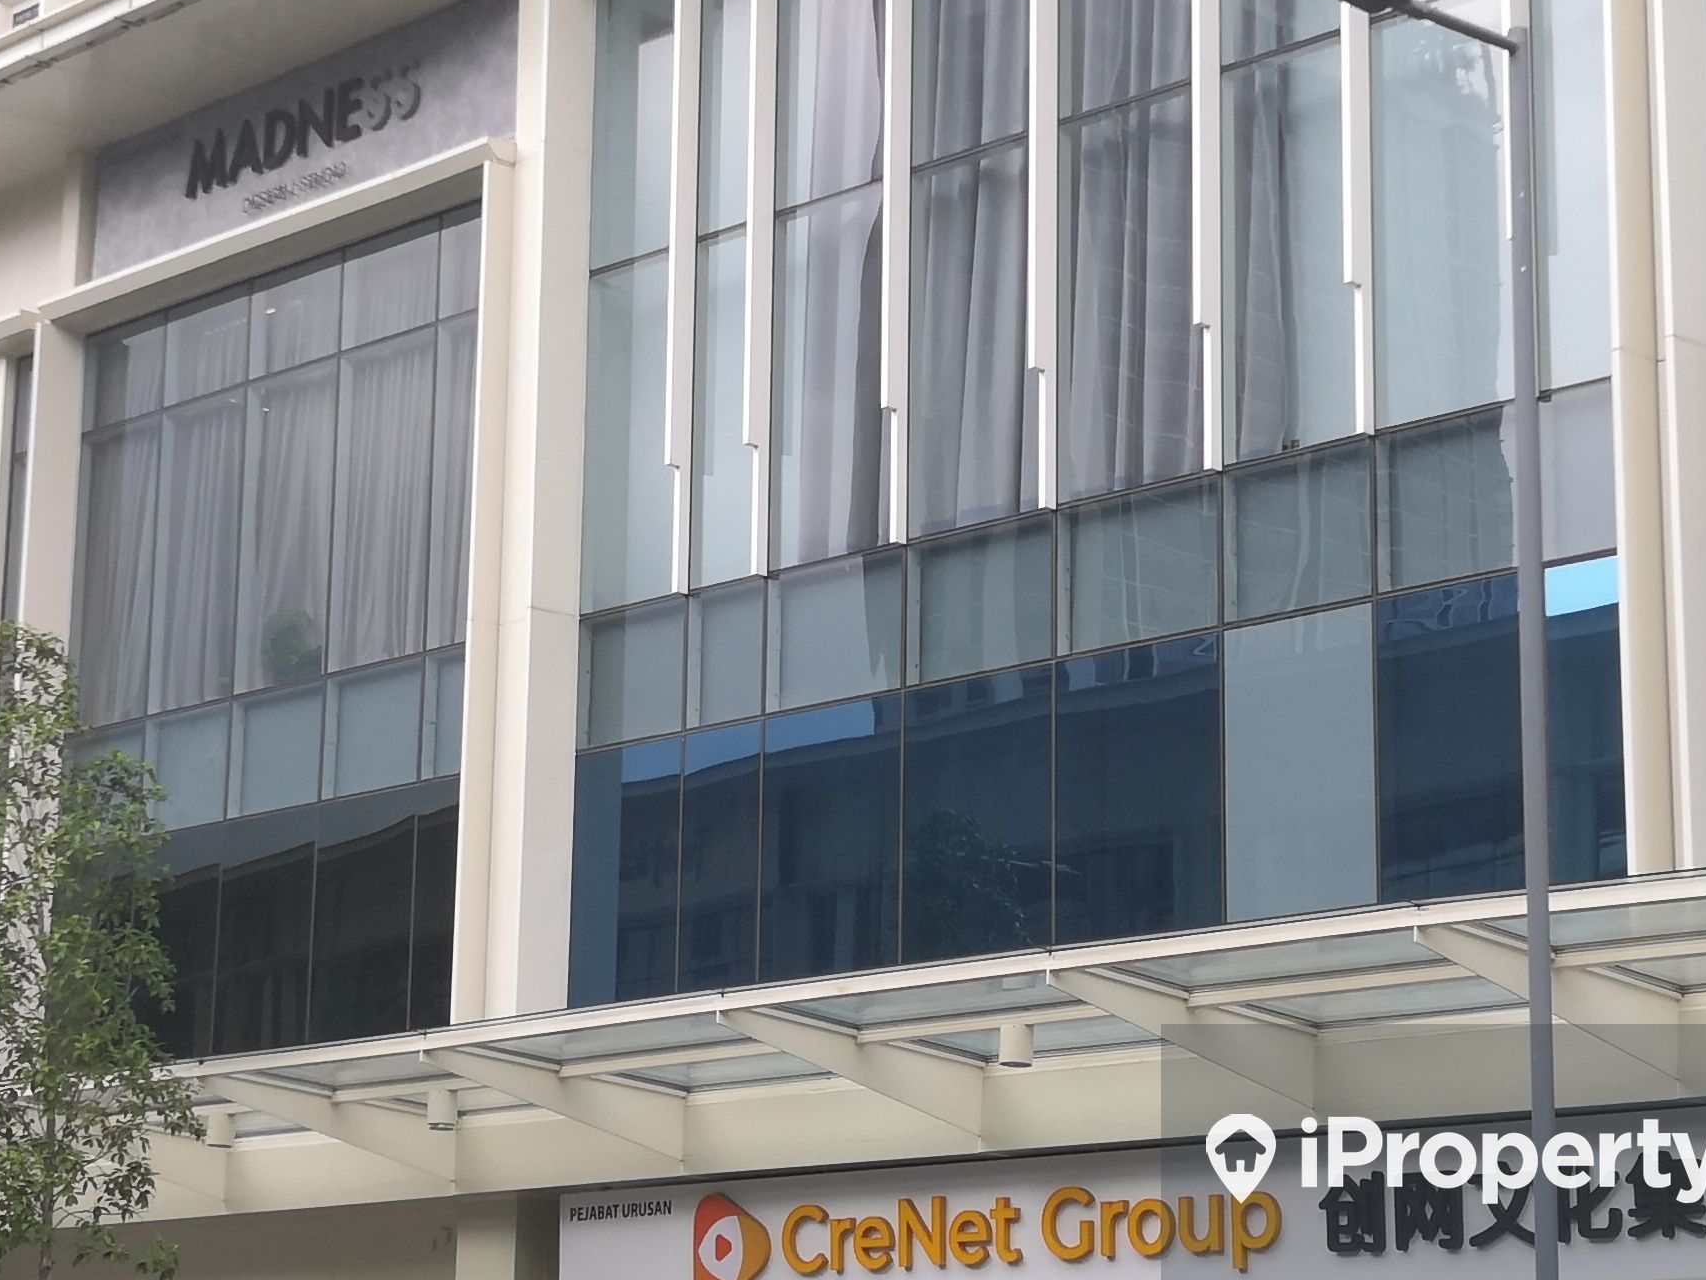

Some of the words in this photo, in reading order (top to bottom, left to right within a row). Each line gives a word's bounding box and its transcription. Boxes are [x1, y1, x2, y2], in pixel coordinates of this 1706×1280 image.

[569, 1202, 620, 1222] PEJABAT
[622, 1200, 673, 1218] URUSAN
[782, 1194, 1023, 1276] CreNet
[1041, 1186, 1283, 1274] Group
